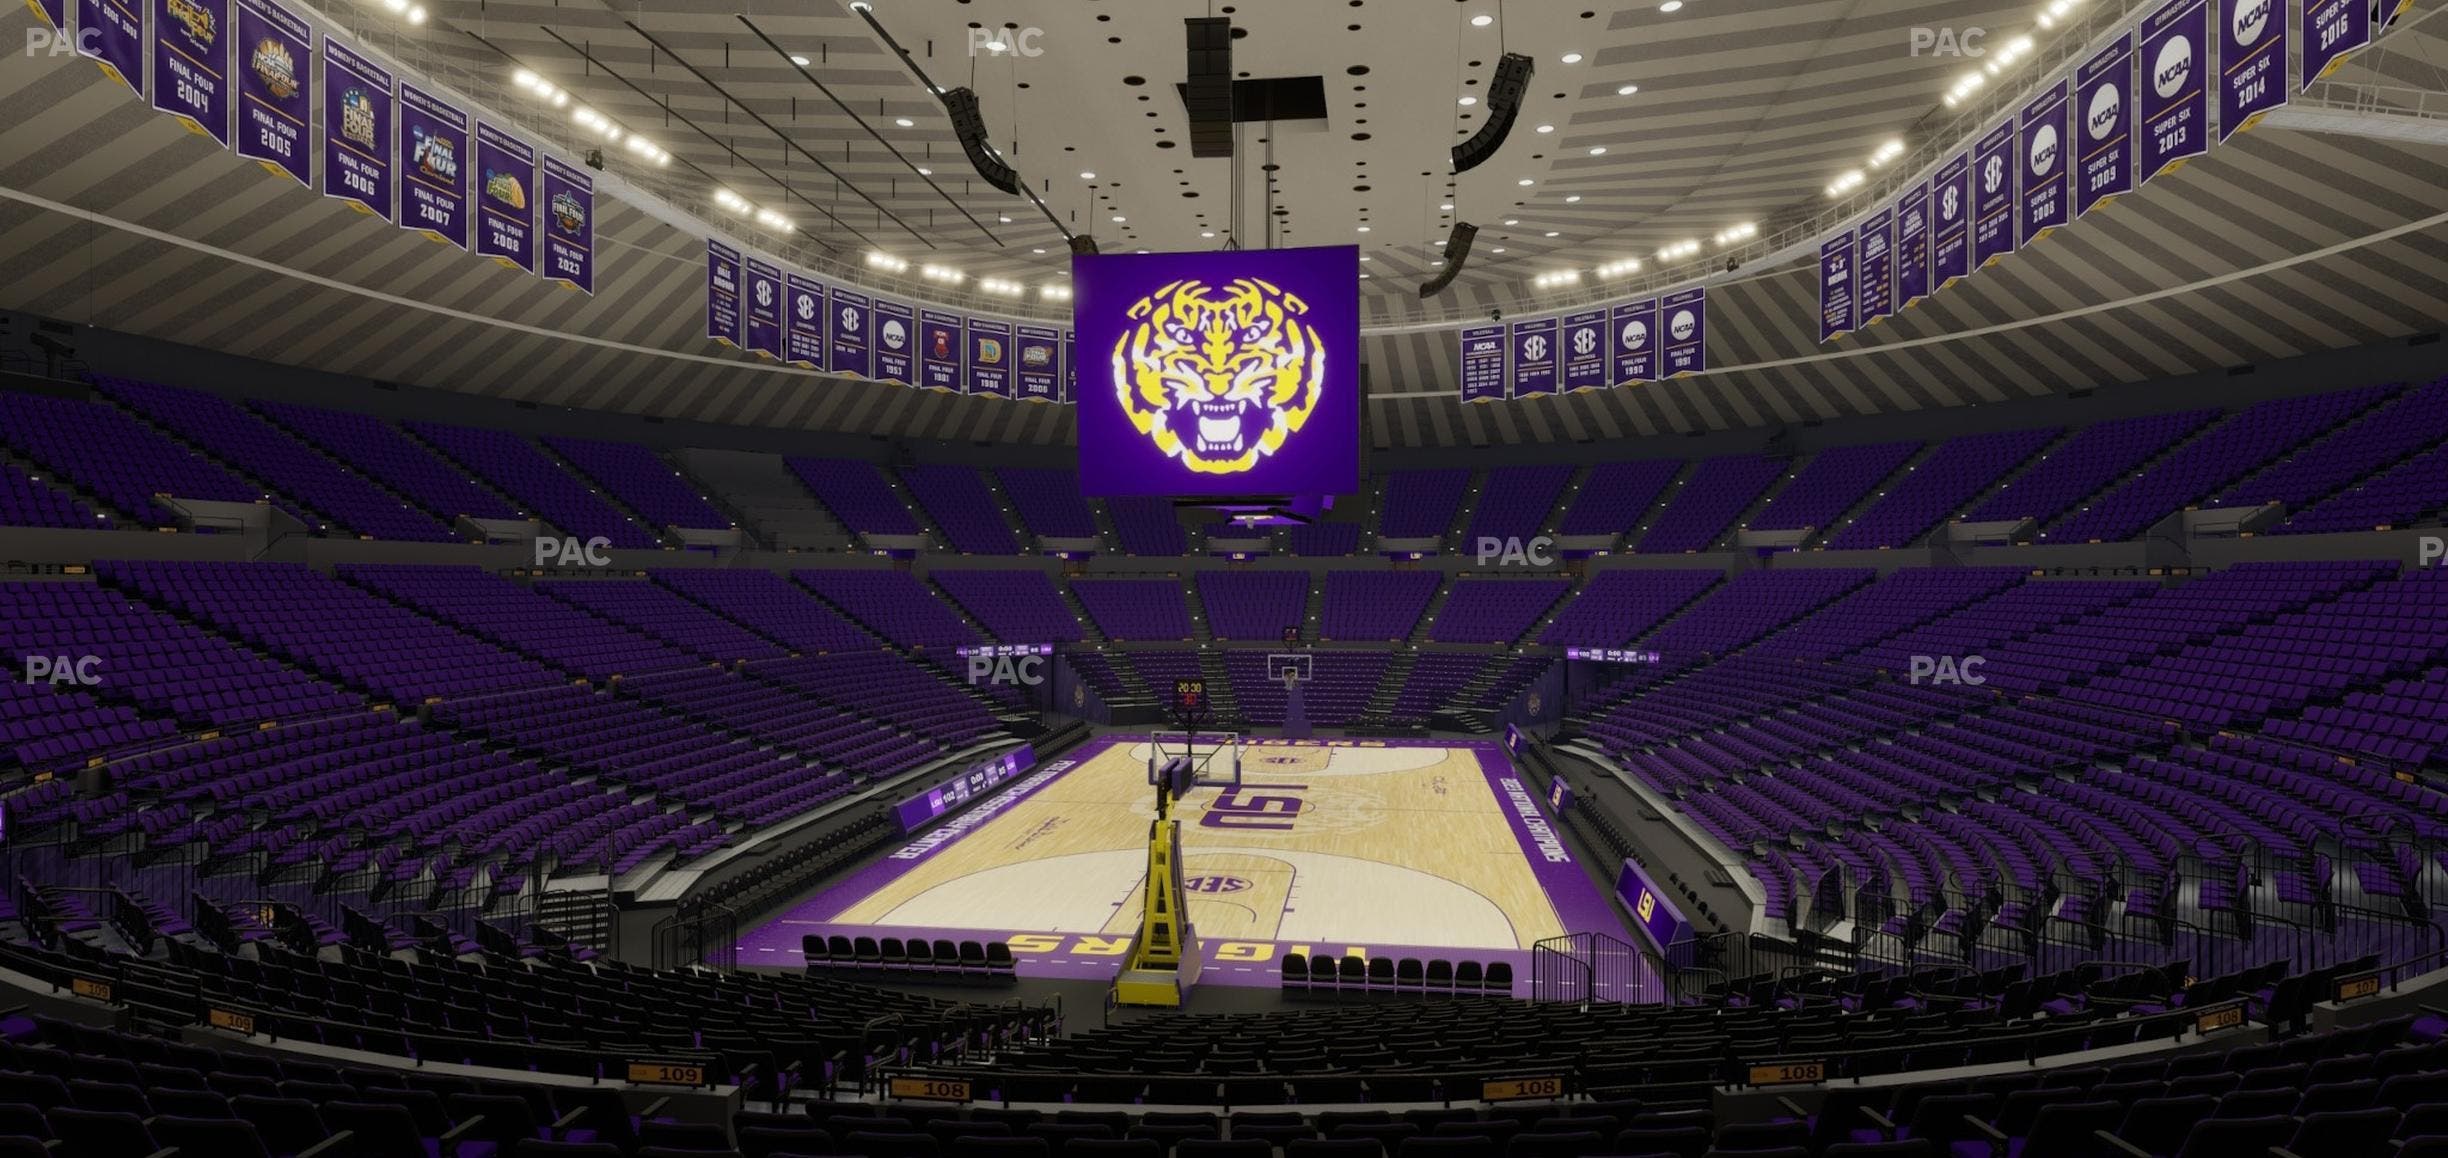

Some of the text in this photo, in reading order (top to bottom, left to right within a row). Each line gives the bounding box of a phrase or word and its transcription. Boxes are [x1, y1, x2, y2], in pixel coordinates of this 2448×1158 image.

[2237, 0, 2270, 36] NCAA
[2316, 2, 2338, 29] SUPER
[2320, 13, 2348, 51] 2016
[169, 57, 214, 95] FINAL FOUR
[2158, 57, 2190, 88] NCAA
[2233, 54, 2271, 89] SUPER SIX
[177, 79, 208, 113] 2004
[2238, 76, 2265, 109] 2014
[252, 108, 297, 141] FINAL FOUR
[2092, 103, 2118, 130] NCAA
[2154, 107, 2191, 137] SUPER SIX
[261, 128, 291, 158] 2005
[2159, 126, 2186, 154] 2013
[338, 152, 380, 180] FINAL FOUR
[2034, 143, 2056, 168] NCAA
[2088, 150, 2120, 174] SUPER SIX
[344, 170, 375, 196] 2006
[1984, 155, 2002, 194] SEC
[2091, 165, 2117, 192] 2009
[414, 188, 454, 211] FINAL FOUR
[1942, 184, 1958, 220] SEC
[2030, 185, 2058, 208] SUPER SIX
[420, 203, 450, 226] 2007
[2032, 200, 2056, 224] 2008
[488, 217, 524, 239] FINAL FOUR
[492, 232, 520, 252] 2008
[553, 243, 569, 257] FINAL
[558, 257, 580, 275] 2023
[796, 294, 814, 320] SEC
[842, 307, 860, 332] SEC
[1574, 328, 1596, 354] SEC
[1625, 333, 1646, 343] NCAA
[1674, 322, 1693, 334] NCAA
[1473, 342, 1496, 350] NCAA
[1524, 335, 1546, 360] SEC
[886, 364, 902, 376] 1953
[1626, 365, 1644, 376] 1990
[1675, 356, 1691, 367] 1991
[1200, 783, 1308, 830] LSU
[1507, 791, 1541, 817] NATIONAL
[887, 828, 954, 859] CENTER
[1523, 818, 1570, 862] CHAMPIONS
[1185, 876, 1244, 892] SEC
[1637, 886, 1656, 923] LSU
[660, 1068, 697, 1082] 109
[1780, 1066, 1818, 1080] 108
[924, 1082, 964, 1097] 108
[1516, 1080, 1556, 1095] 108
